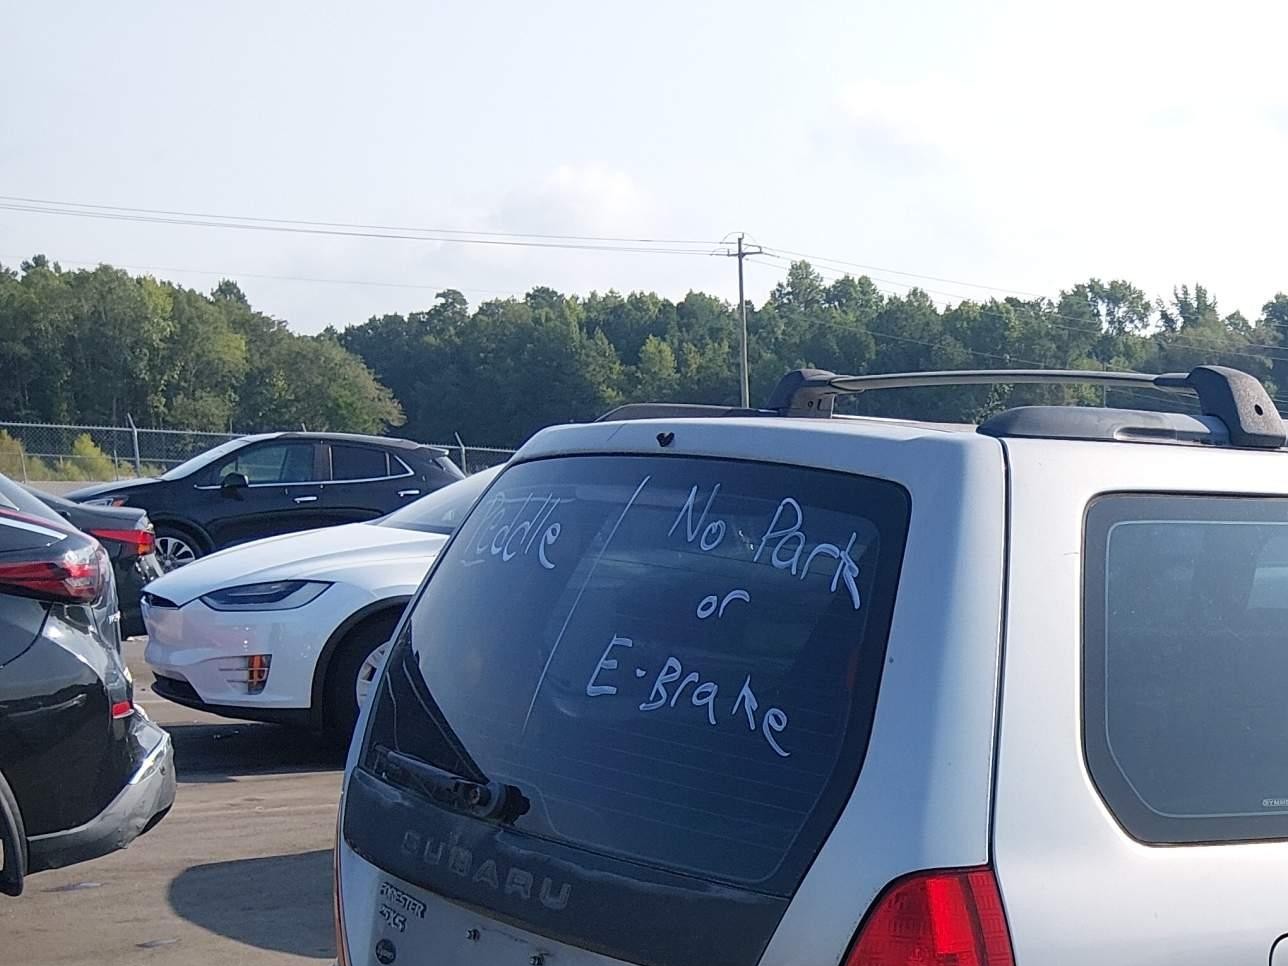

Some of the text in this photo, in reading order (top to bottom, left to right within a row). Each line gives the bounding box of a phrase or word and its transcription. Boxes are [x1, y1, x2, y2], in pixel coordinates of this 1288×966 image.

[667, 483, 861, 609] No Park
[696, 589, 751, 619] or
[379, 881, 428, 919] FORESTER
[402, 830, 573, 911] SUBARU
